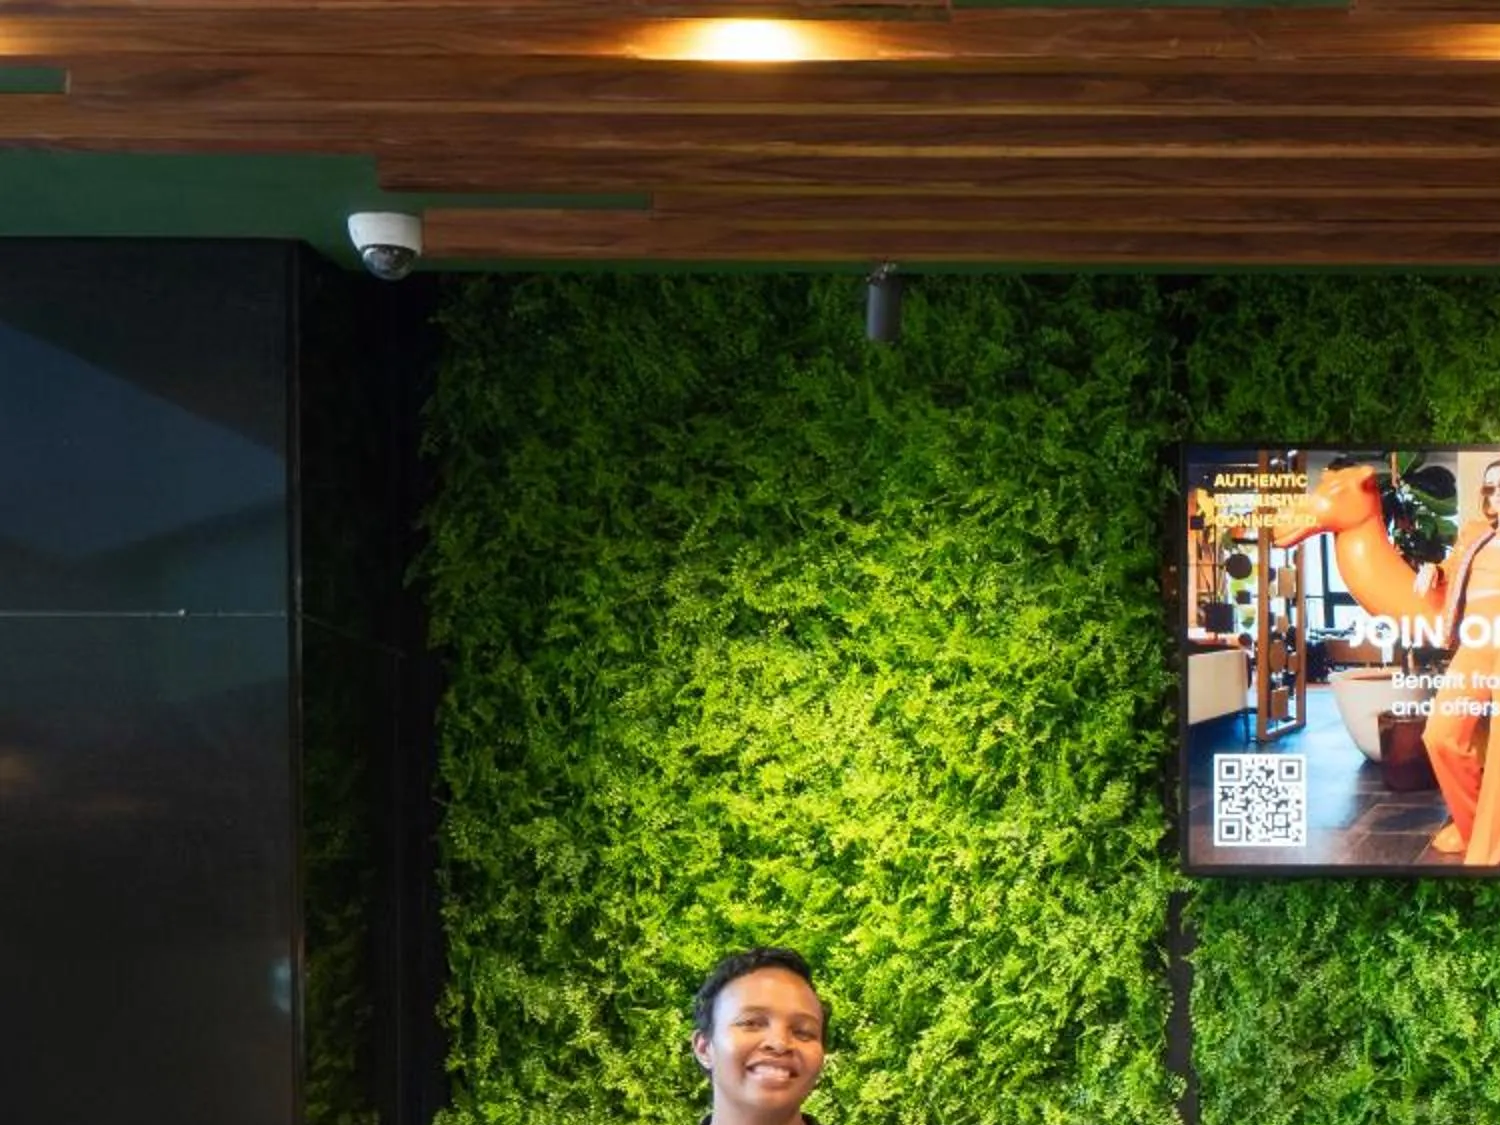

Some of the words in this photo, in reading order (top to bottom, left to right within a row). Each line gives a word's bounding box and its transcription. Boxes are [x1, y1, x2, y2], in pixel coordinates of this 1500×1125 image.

[1214, 473, 1308, 487] AUTHENTIC
[1349, 615, 1444, 648] JOIN
[1391, 673, 1465, 689] Benefit
[1391, 698, 1435, 715] and
[1440, 697, 1500, 716] offers
